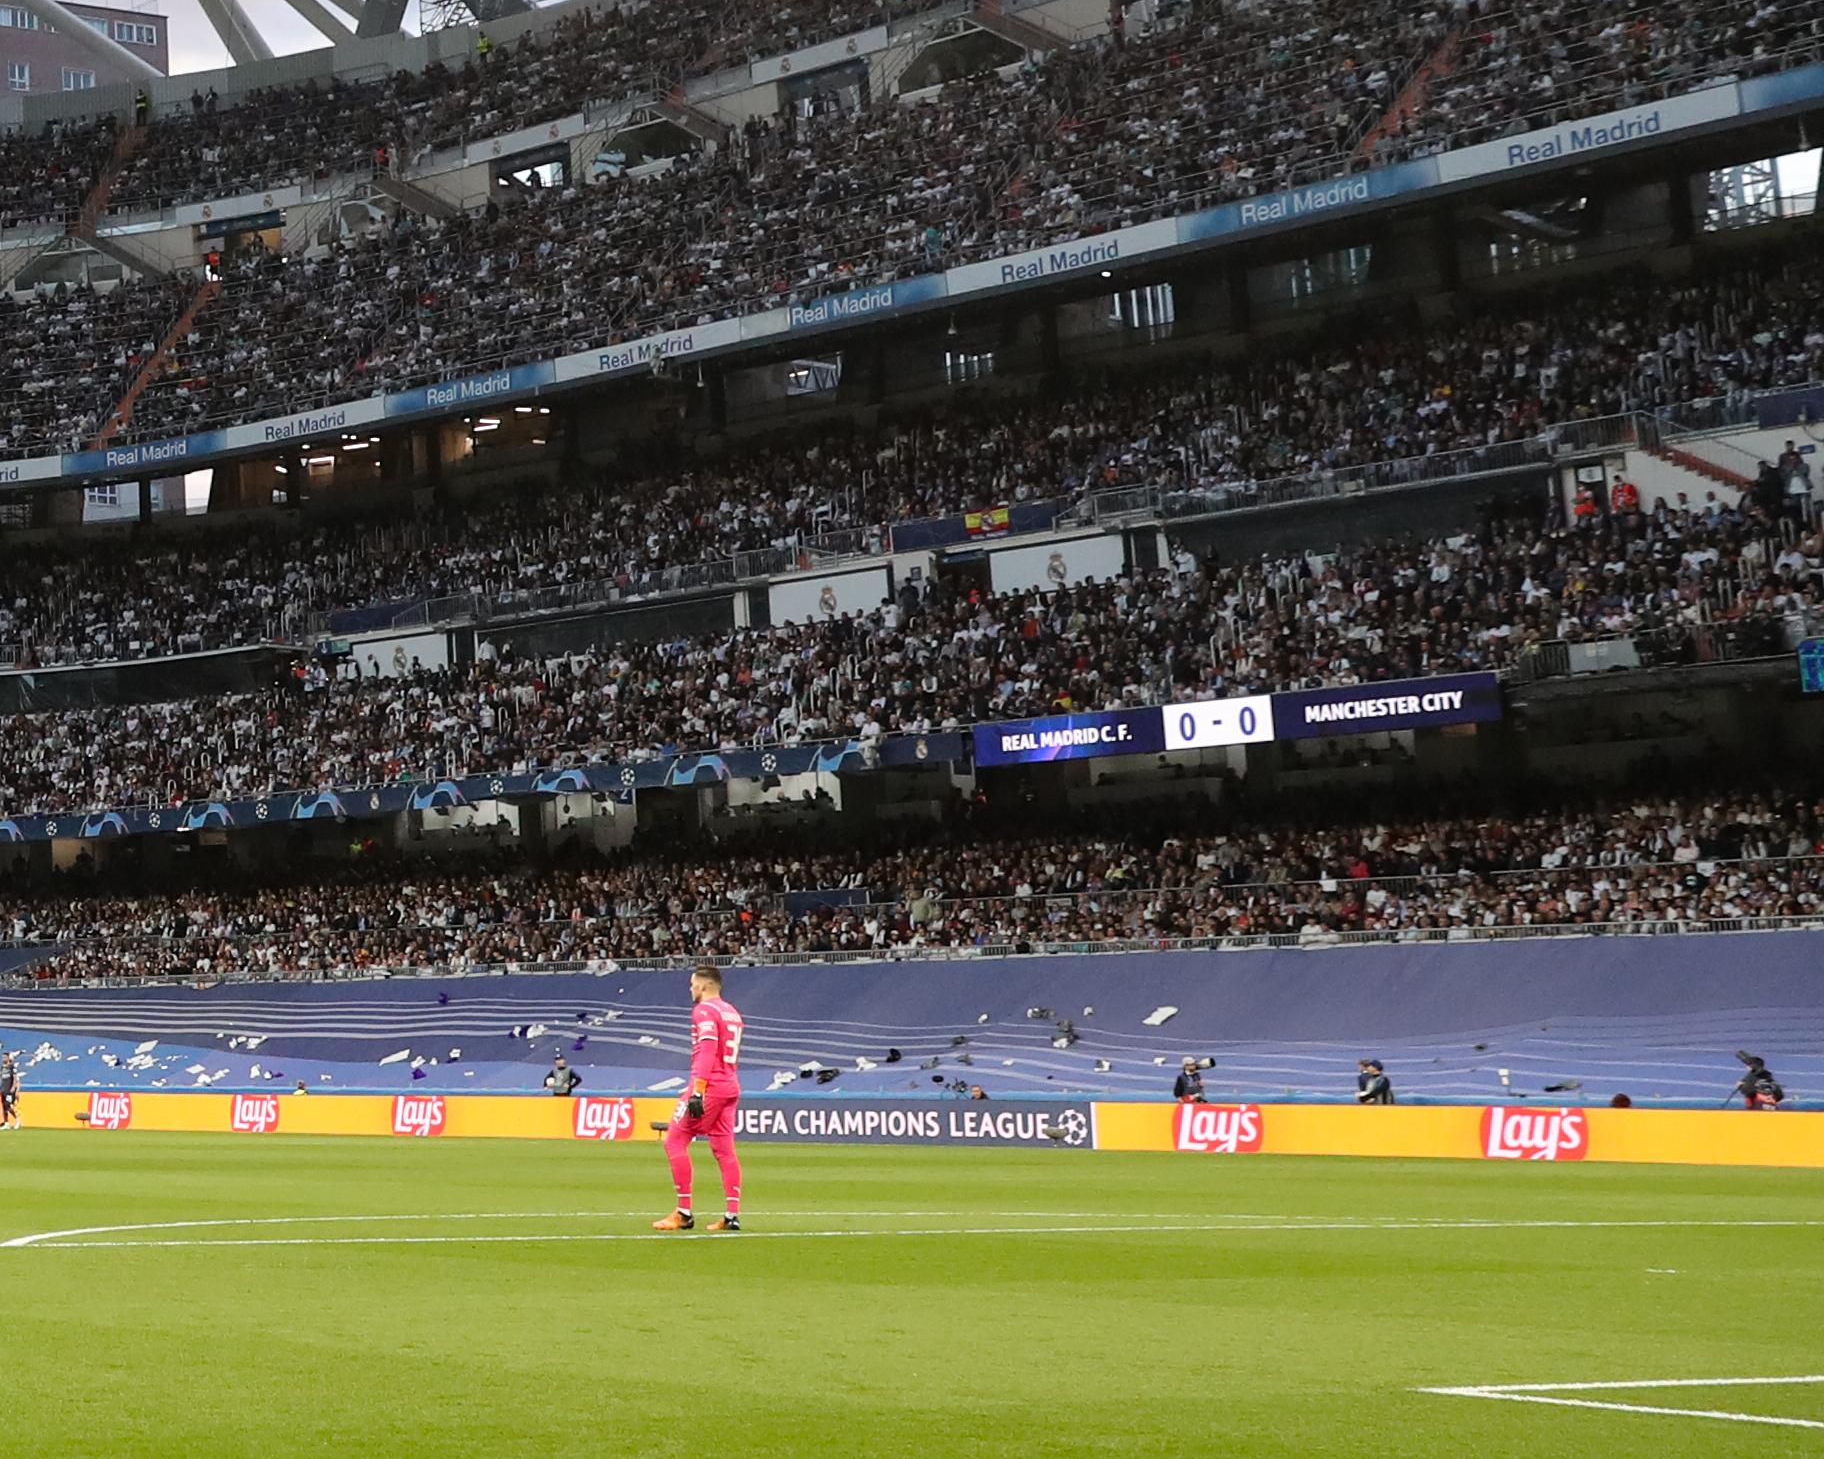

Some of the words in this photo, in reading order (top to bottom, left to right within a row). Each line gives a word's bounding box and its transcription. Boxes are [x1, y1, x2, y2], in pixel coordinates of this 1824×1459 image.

[1507, 141, 1562, 165] Real
[1570, 111, 1660, 150] Madrid
[1241, 199, 1287, 224] Real
[1293, 176, 1368, 213] Madrid
[1001, 260, 1044, 282] Real
[1050, 240, 1119, 270] Madrid
[792, 303, 828, 325] Real
[833, 289, 892, 314] Madrid
[599, 349, 634, 370] Real
[426, 388, 457, 405] Real
[461, 374, 510, 398] Madrid
[265, 424, 294, 441] Real
[298, 414, 345, 435] Madrid
[106, 448, 138, 466] Real
[142, 440, 186, 461] Madrid
[1178, 712, 1196, 742] 0
[1239, 706, 1257, 736] 0
[1304, 695, 1421, 723] MANCHESTER
[1422, 691, 1464, 712] CITY
[1001, 733, 1039, 752] REAL
[1040, 727, 1099, 748] MADRID
[1100, 725, 1116, 742] C.
[1117, 723, 1132, 741] F.
[90, 1092, 130, 1129] Lay's
[233, 1094, 277, 1133] Lay's
[393, 1095, 443, 1136] Lay's
[575, 1097, 632, 1141] Lay's
[794, 1110, 940, 1137] CHAMPIONS
[950, 1111, 1050, 1139] LEAGUE
[1177, 1104, 1259, 1153] Lay's
[1487, 1106, 1583, 1161] Lay's
